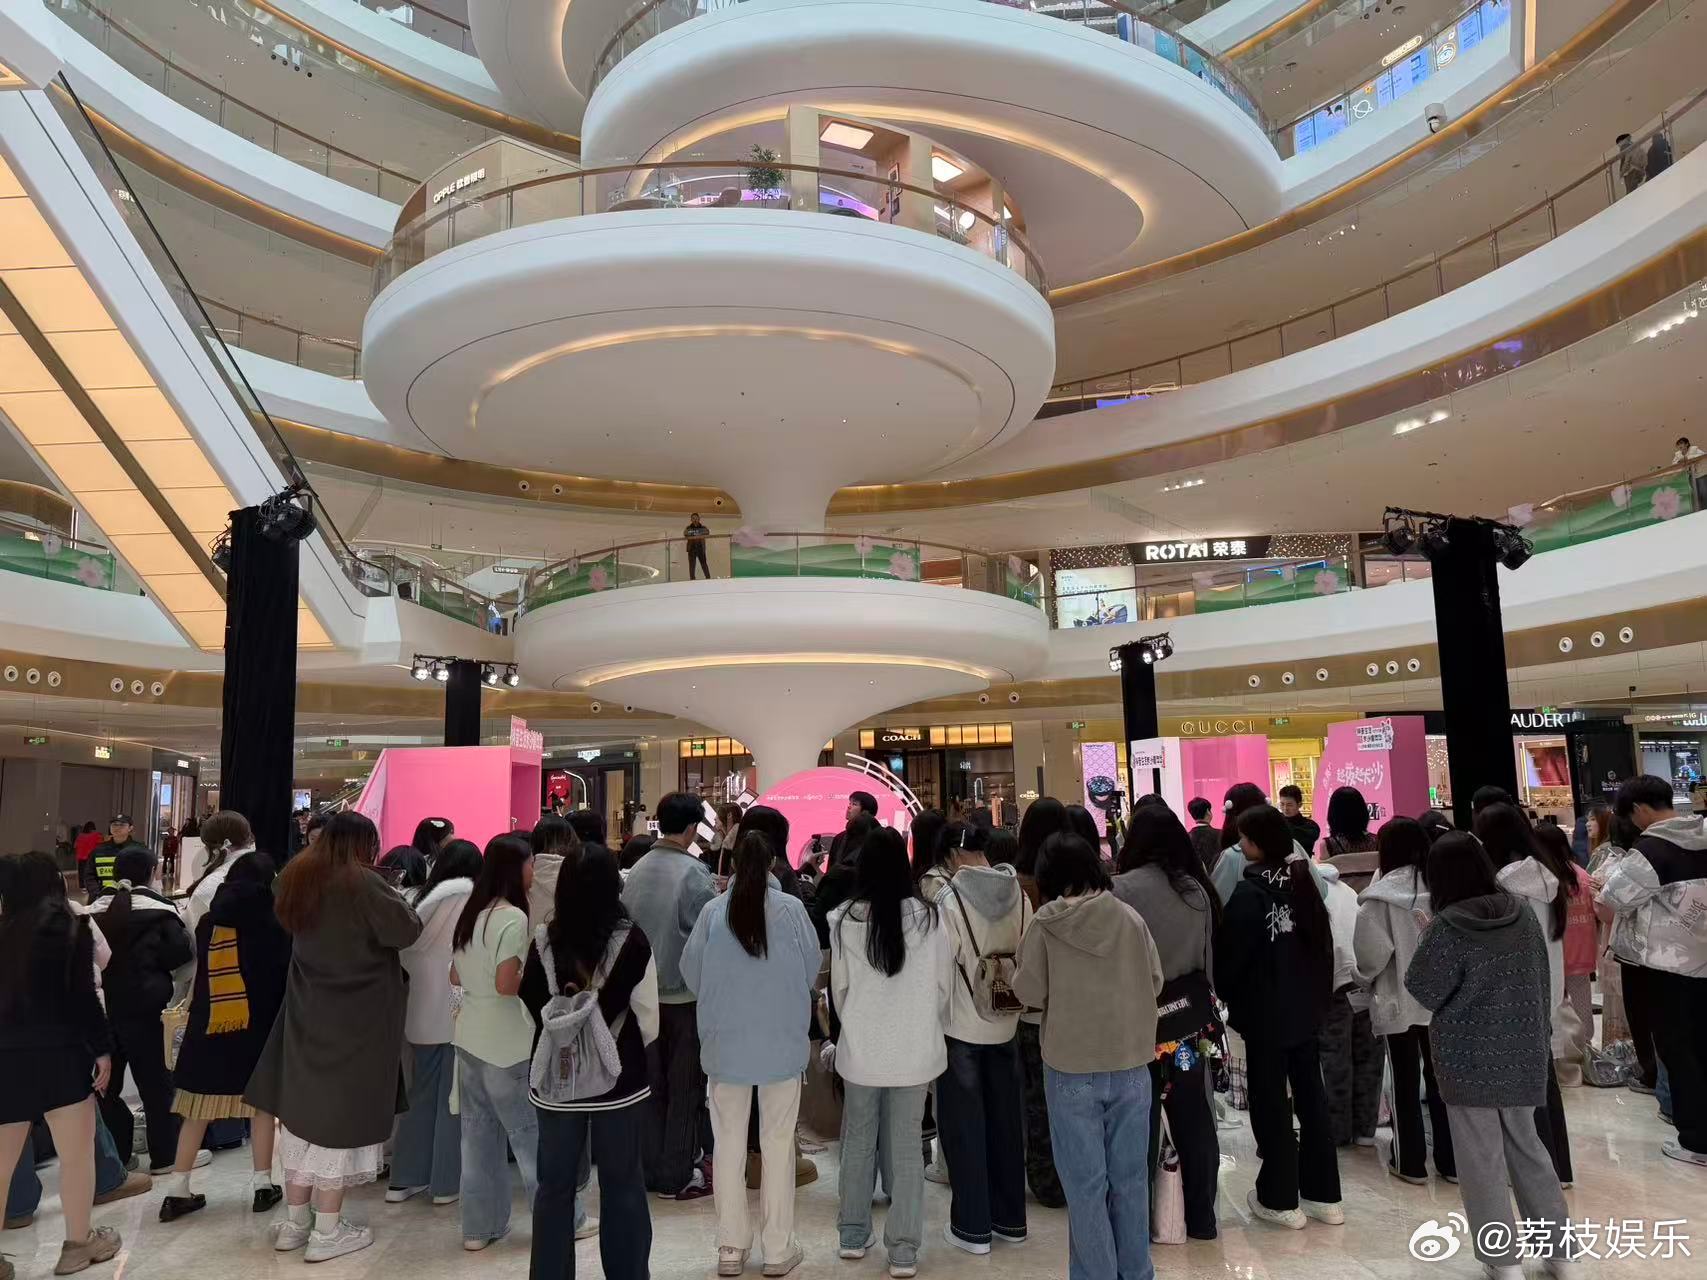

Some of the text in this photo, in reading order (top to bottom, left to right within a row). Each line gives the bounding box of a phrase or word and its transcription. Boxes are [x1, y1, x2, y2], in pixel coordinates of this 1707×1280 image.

[433, 182, 457, 204] OPPLE
[1145, 540, 1248, 561] ROTAI 荣泰
[1181, 720, 1255, 735] GUCCI
[882, 734, 921, 742] COACH
